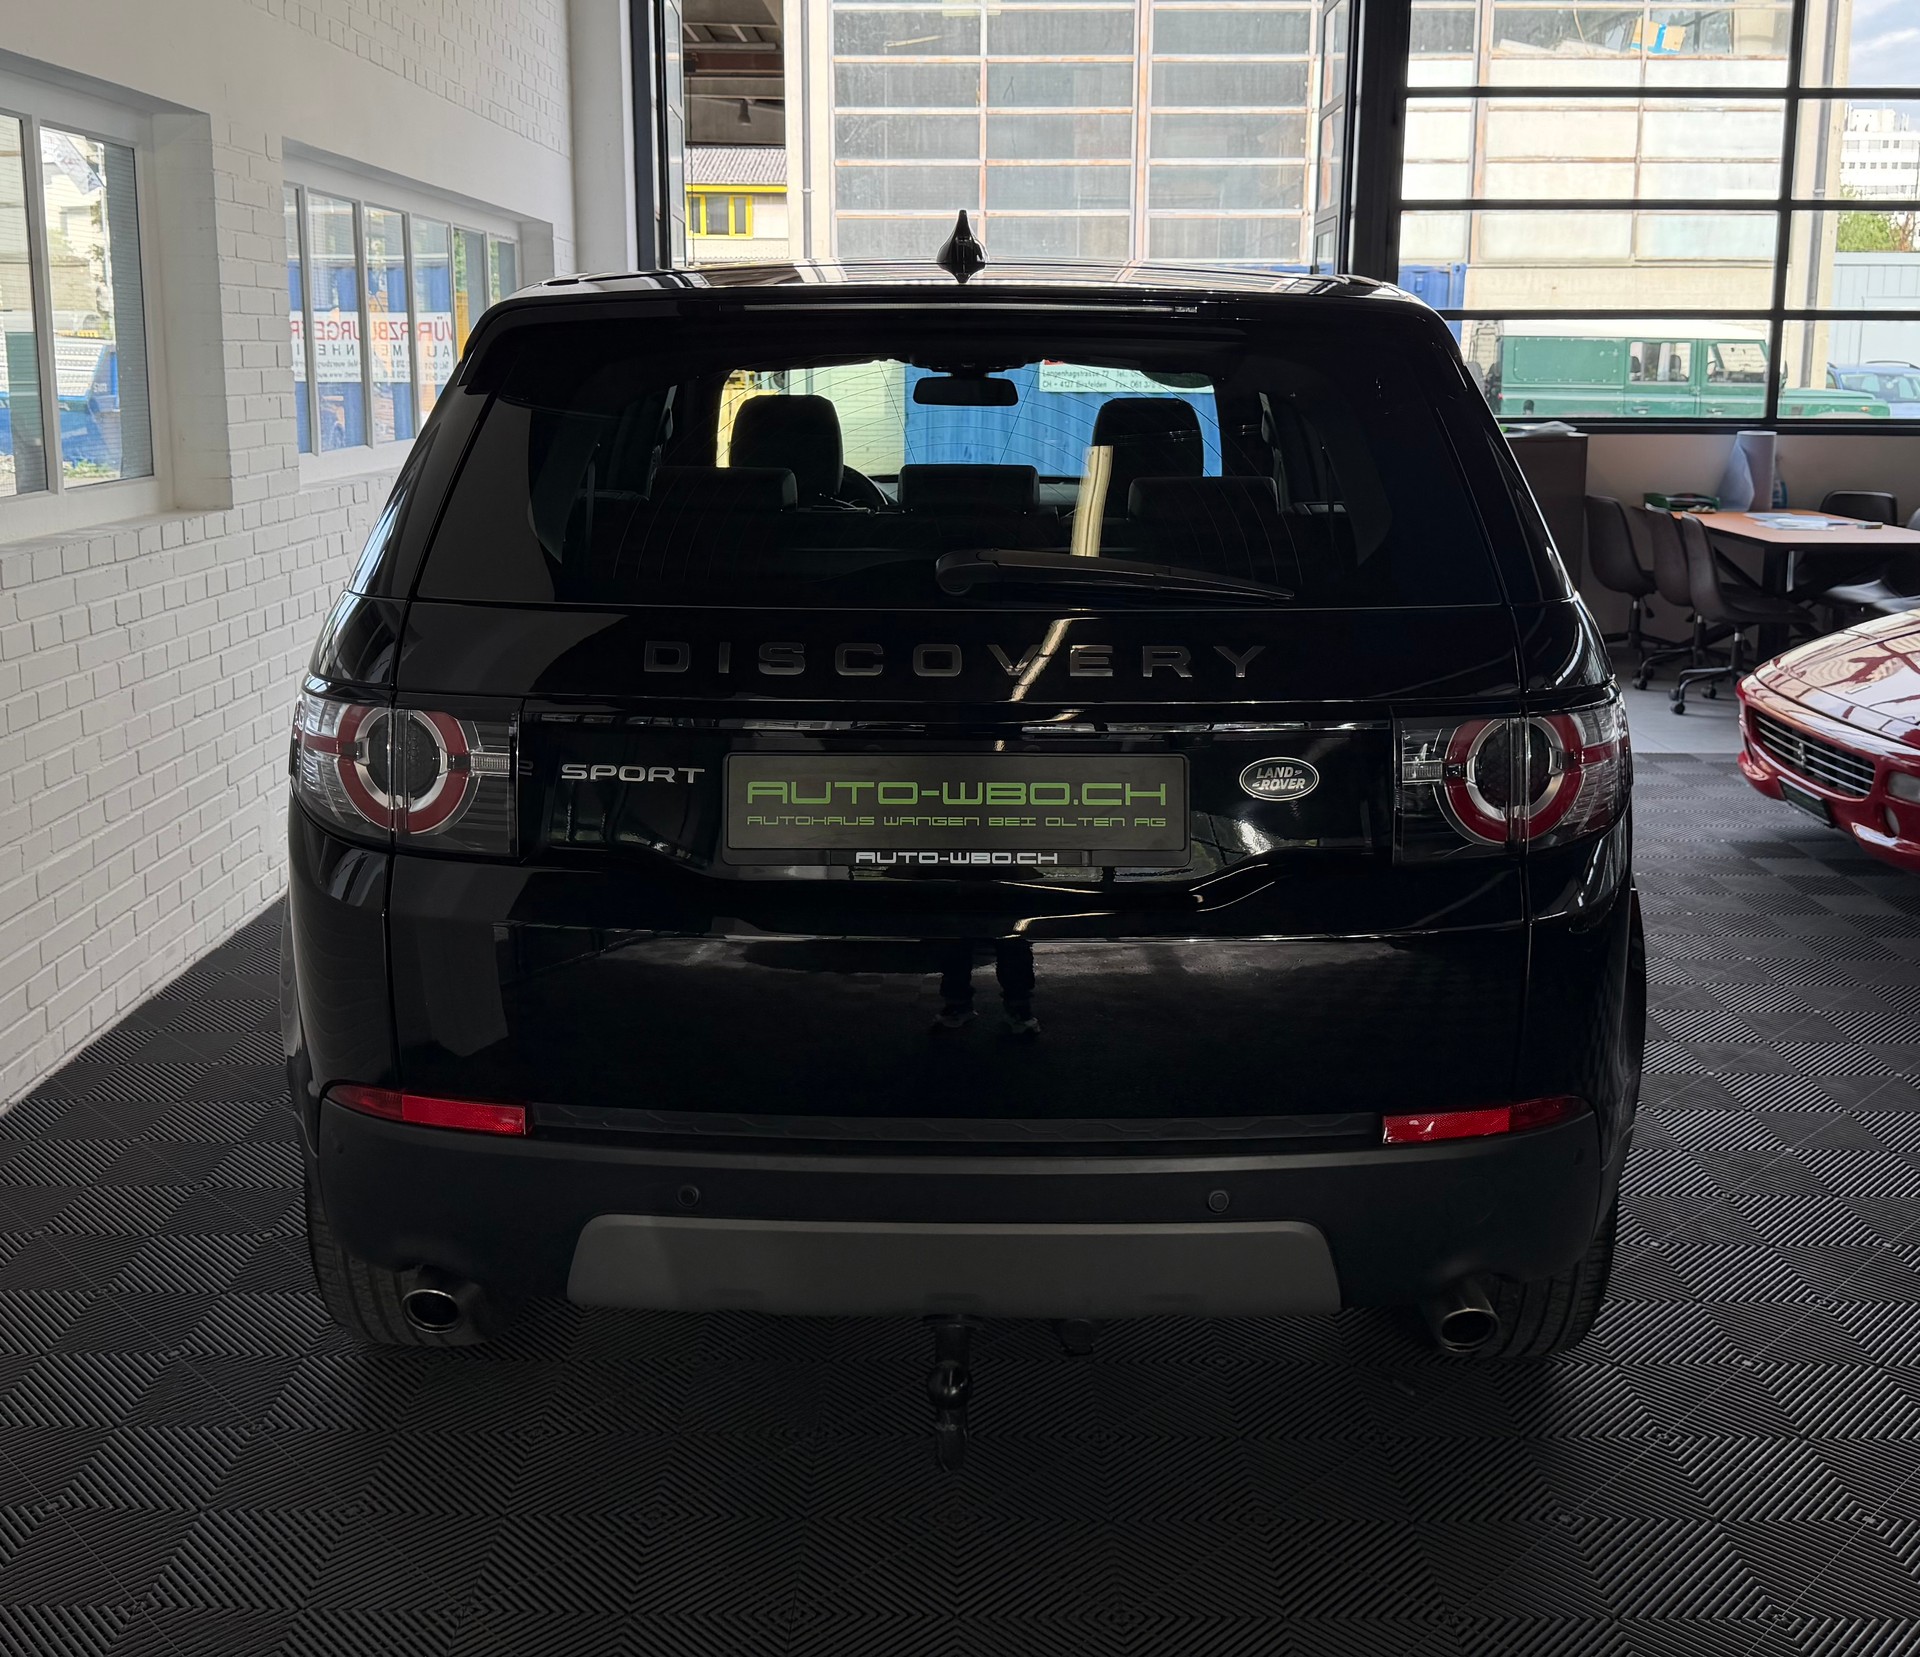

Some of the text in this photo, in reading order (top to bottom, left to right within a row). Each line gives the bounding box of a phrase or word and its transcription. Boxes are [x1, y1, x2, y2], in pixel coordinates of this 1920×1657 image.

[644, 640, 1266, 678] DISCOVERY
[561, 763, 706, 784] SPORT
[1256, 766, 1294, 779] LAND
[1260, 778, 1306, 790] ROVER
[747, 781, 1167, 806] AUTO-WBO.CH
[747, 815, 1167, 827] AUTOHAUS WANGEN BEI OLTEN AG
[855, 851, 1059, 865] AUTO-WBO.CH
